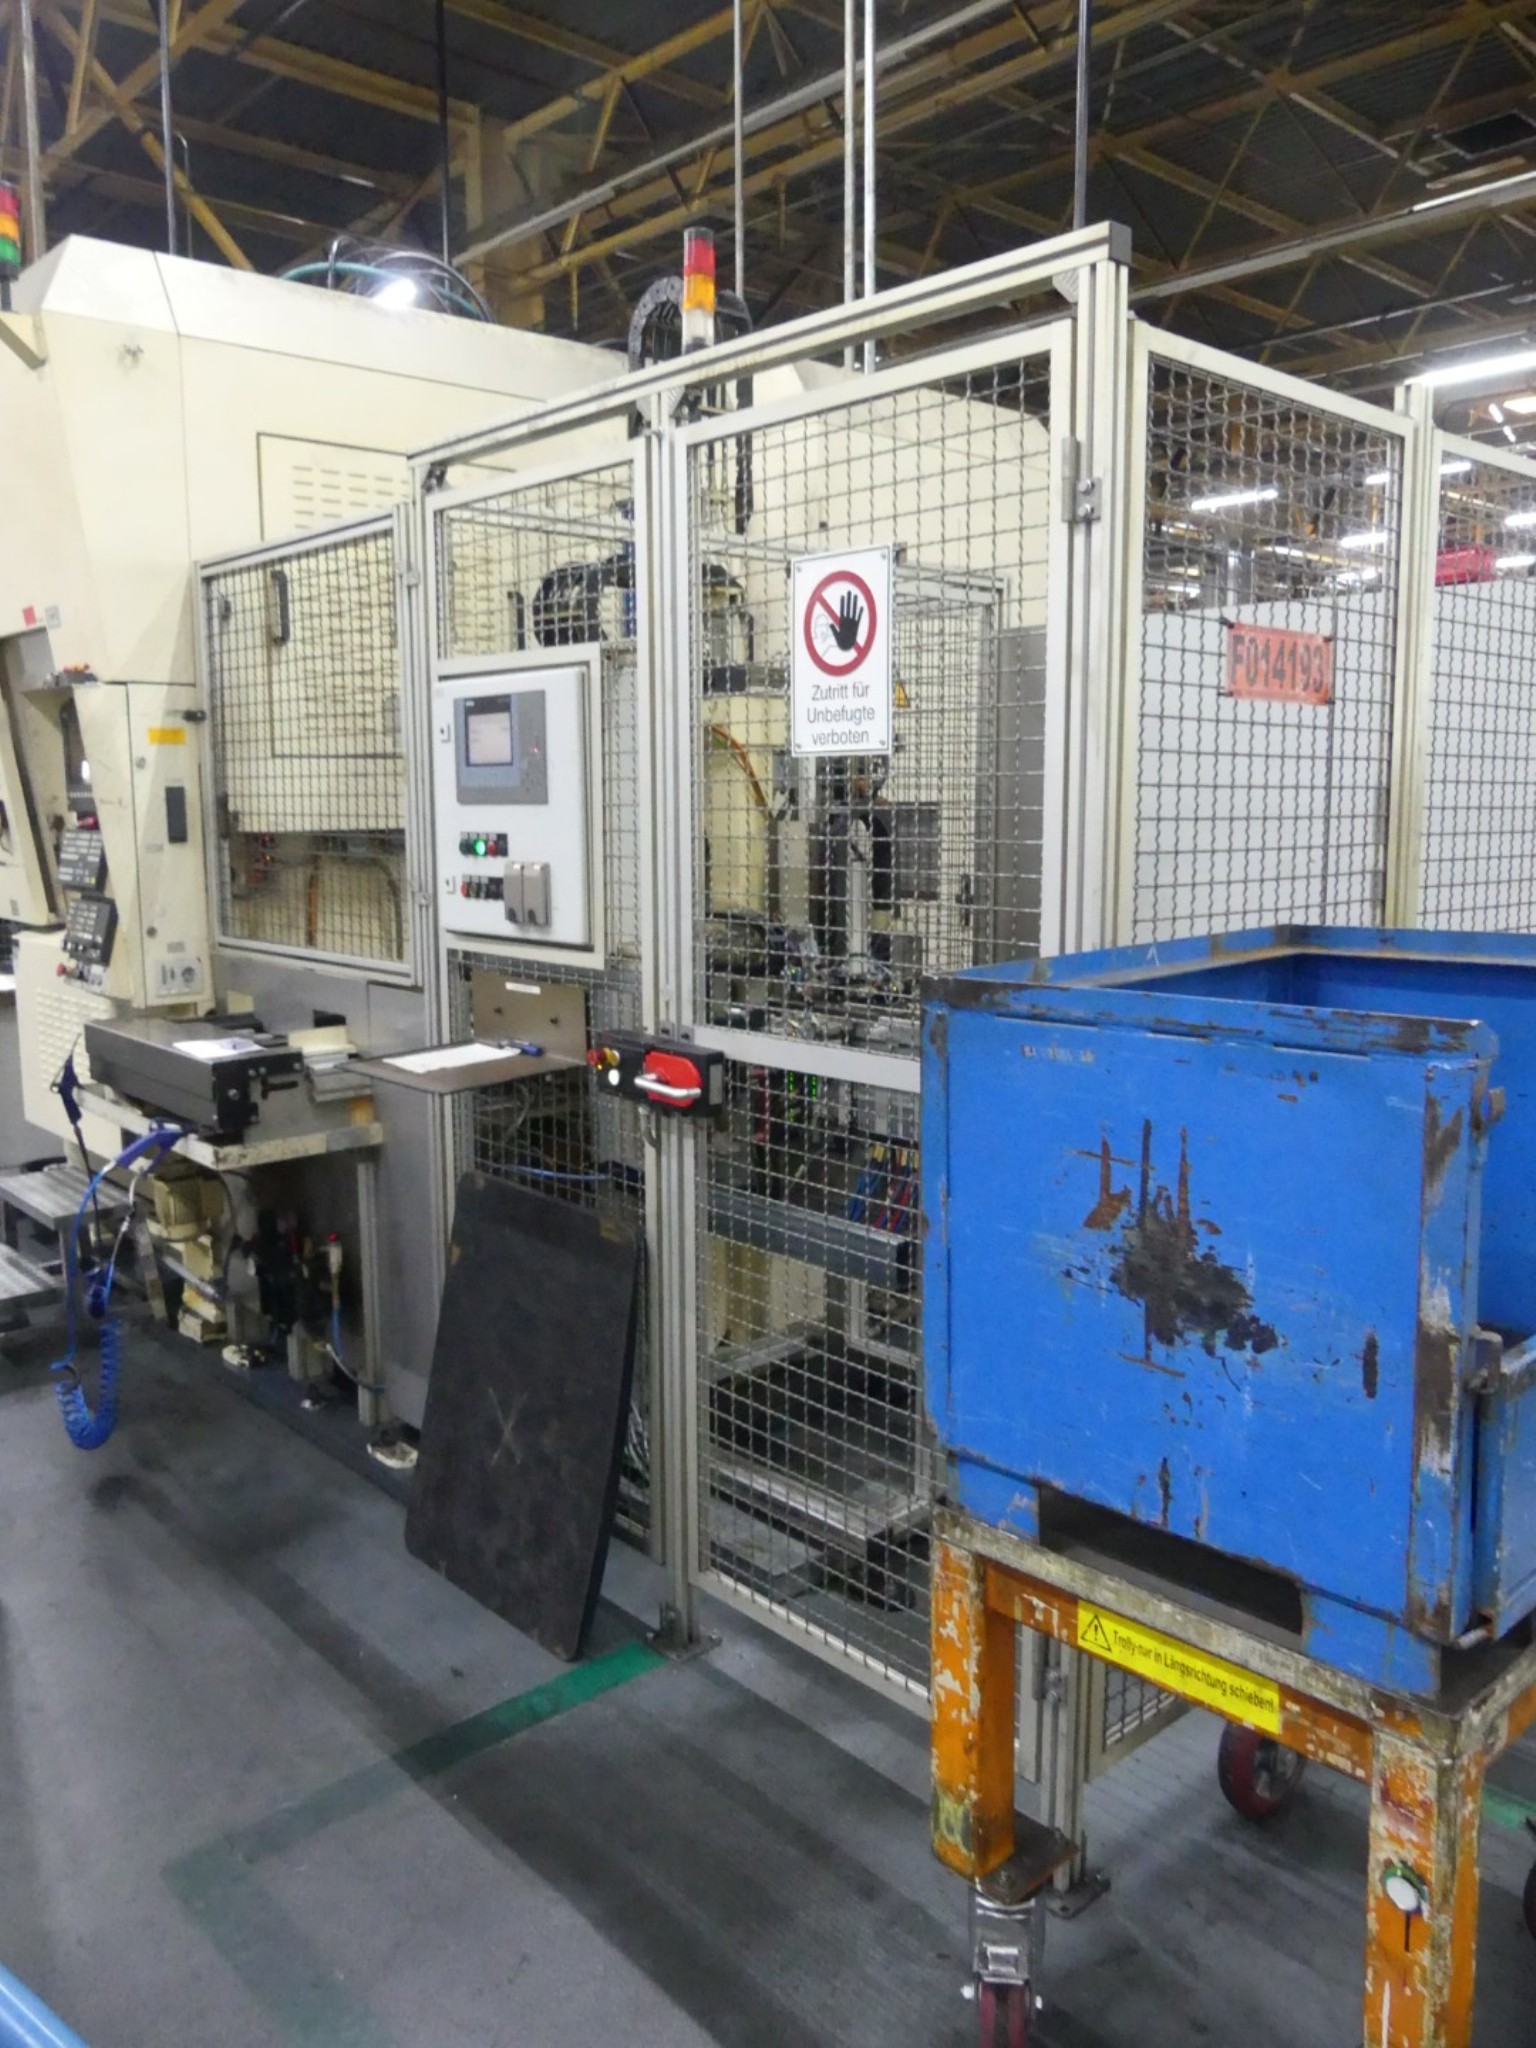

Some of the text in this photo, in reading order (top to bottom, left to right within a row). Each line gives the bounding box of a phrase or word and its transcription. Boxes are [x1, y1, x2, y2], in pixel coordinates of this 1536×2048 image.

[1231, 634, 1324, 693] F014193
[811, 681, 870, 701] Zutritt für
[807, 704, 875, 725] Unbefugte
[811, 728, 870, 745] verboten
